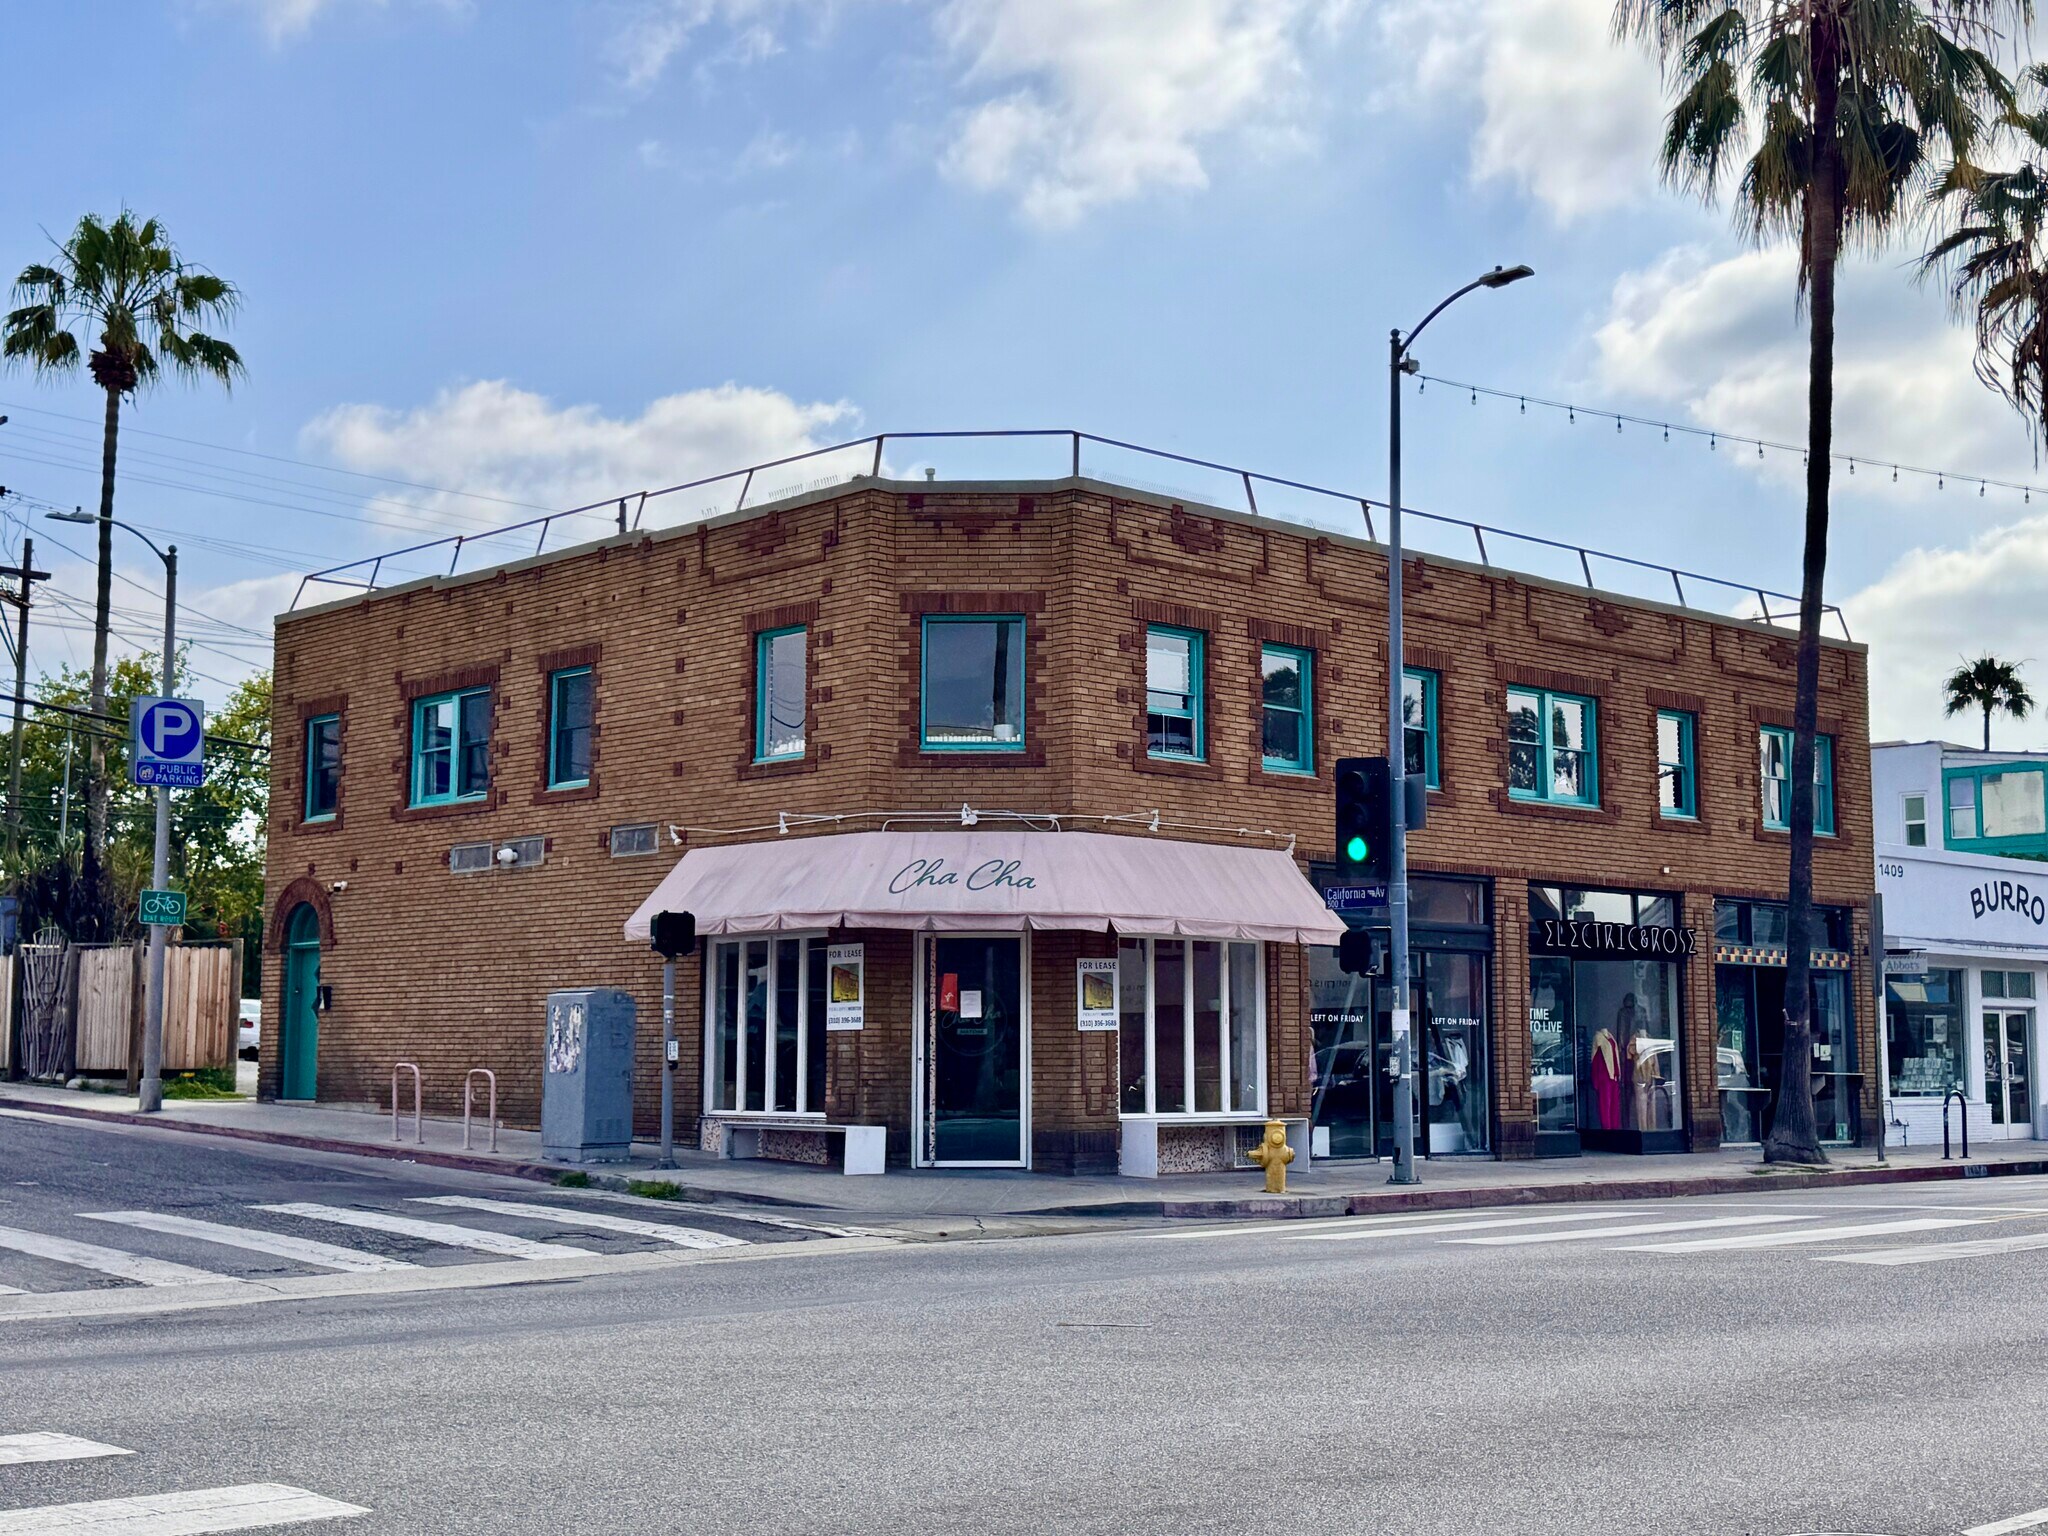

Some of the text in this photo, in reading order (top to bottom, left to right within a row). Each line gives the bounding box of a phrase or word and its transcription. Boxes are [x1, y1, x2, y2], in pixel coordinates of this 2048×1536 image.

[154, 706, 192, 752] P
[159, 764, 197, 775] PUBLIC
[155, 773, 200, 785] PARKING
[888, 858, 1037, 894] Cha Cha
[1879, 863, 1904, 878] 1409
[1327, 888, 1366, 900] California
[1327, 900, 1345, 908] 500 E
[1970, 880, 2045, 926] BURRO
[844, 949, 861, 957] LEASE
[1310, 1013, 1364, 1023] LEFT ON FRIDAY
[1530, 1008, 1549, 1020] TIME
[1431, 1017, 1480, 1026] LEFT ON FRIDAY
[1530, 1020, 1562, 1032] TO LIVE
